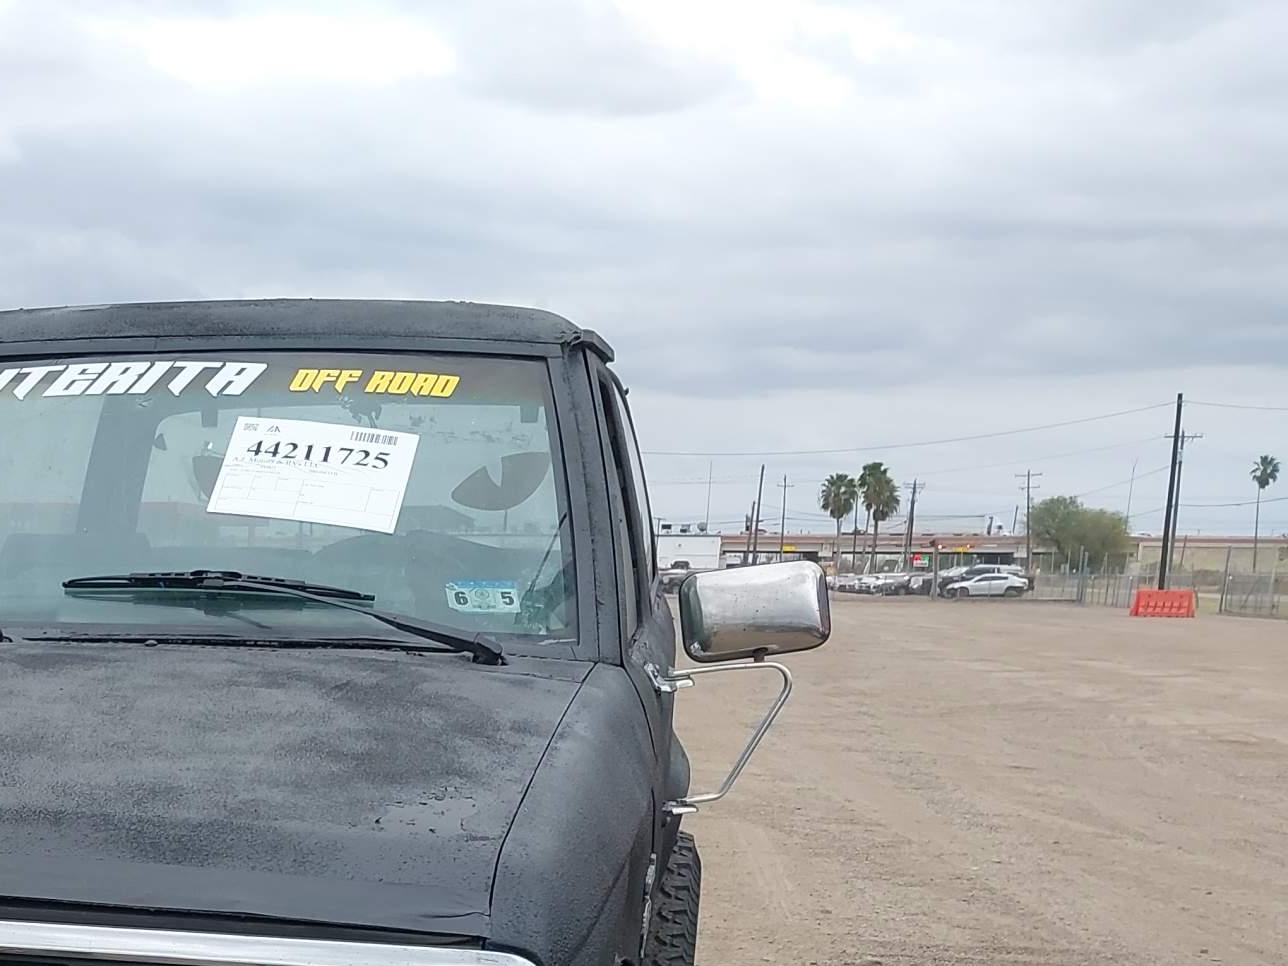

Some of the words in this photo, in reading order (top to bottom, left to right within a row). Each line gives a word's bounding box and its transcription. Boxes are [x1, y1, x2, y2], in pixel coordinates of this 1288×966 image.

[289, 369, 363, 393] OFF
[364, 371, 460, 398] ROAD
[247, 440, 391, 470] 44211725
[454, 591, 469, 606] 6
[500, 591, 515, 606] 5
